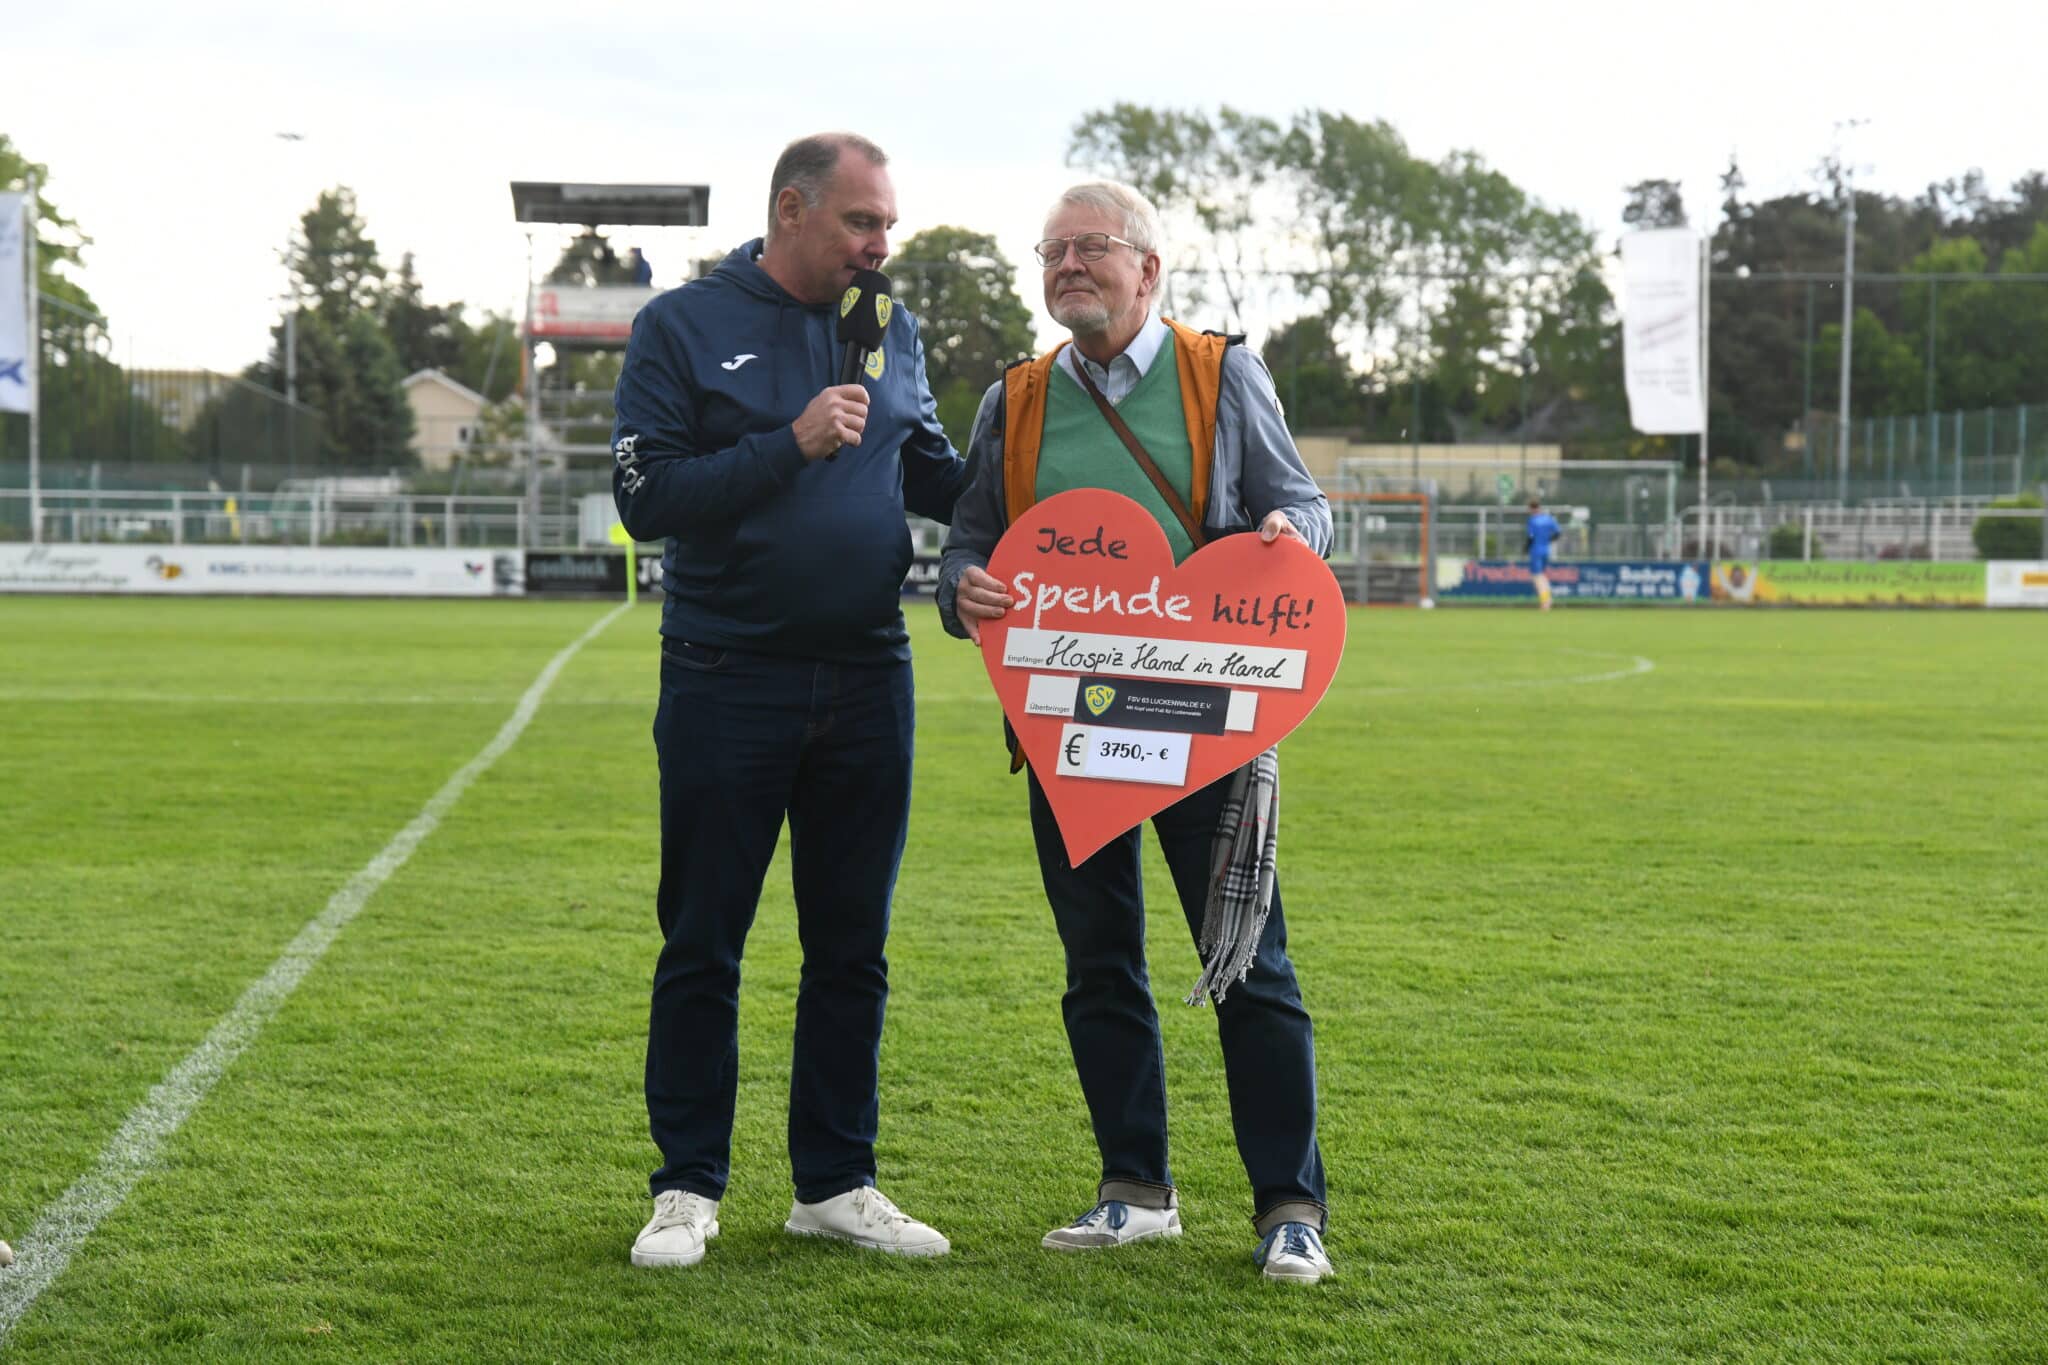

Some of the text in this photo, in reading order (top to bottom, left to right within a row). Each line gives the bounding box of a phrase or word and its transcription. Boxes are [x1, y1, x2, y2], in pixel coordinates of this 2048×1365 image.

[1037, 527, 1128, 559] Jede
[1012, 572, 1314, 637] Spende hilft!
[1008, 655, 1044, 664] Empfänger
[1045, 635, 1287, 679] Hospiz Hand in Hand
[1029, 703, 1070, 713] Überbringer
[1127, 695, 1141, 703] FSV
[1150, 698, 1199, 708] LUCKENWALDE
[1065, 733, 1085, 766] €
[1160, 748, 1169, 760] €
